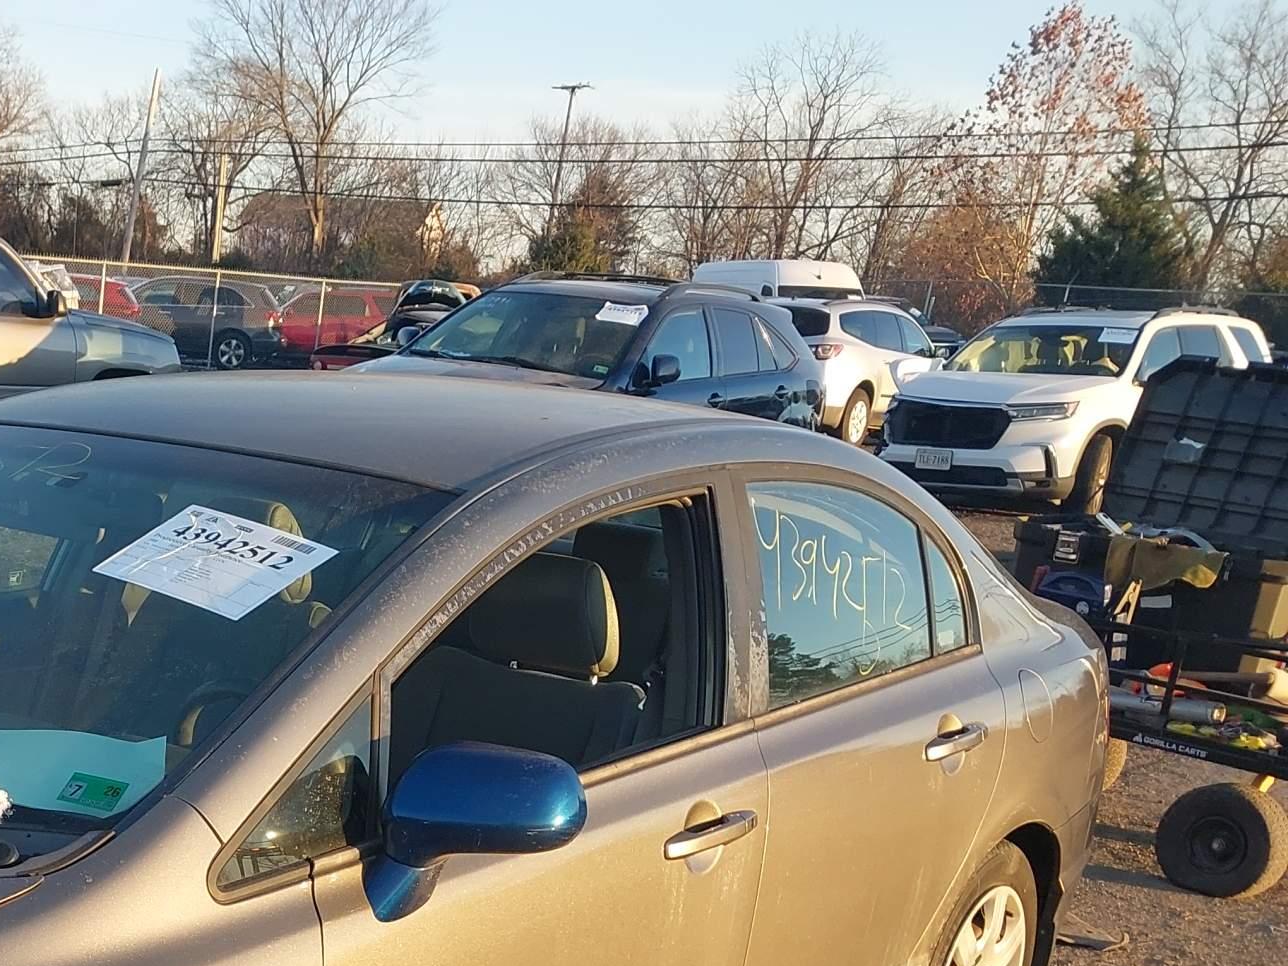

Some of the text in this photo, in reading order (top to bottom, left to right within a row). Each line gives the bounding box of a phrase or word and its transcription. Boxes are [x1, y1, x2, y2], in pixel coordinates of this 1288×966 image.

[172, 524, 295, 571] 43942512
[1143, 736, 1178, 752] GORILLA
[69, 784, 122, 798] 7 26
